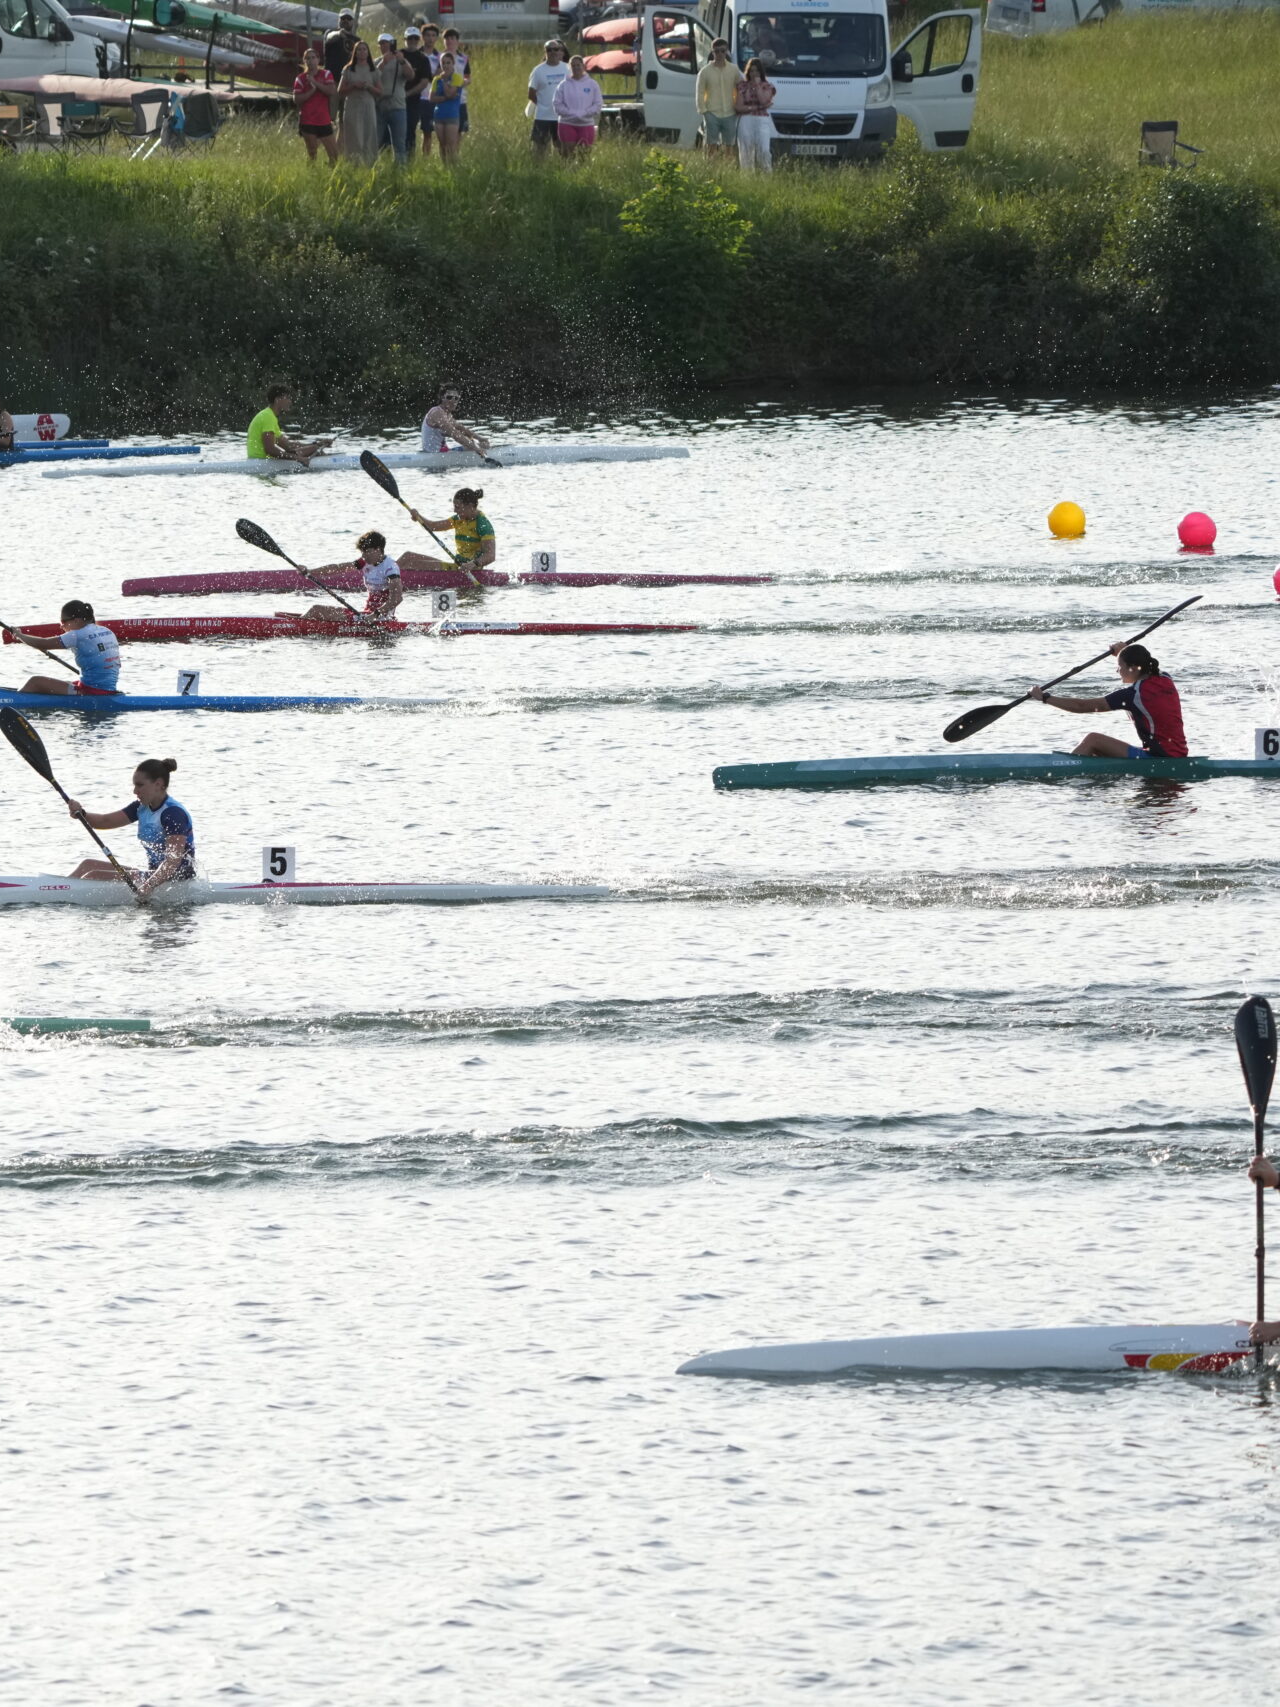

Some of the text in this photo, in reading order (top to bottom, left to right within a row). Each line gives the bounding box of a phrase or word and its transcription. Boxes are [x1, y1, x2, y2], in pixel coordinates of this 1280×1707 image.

[539, 553, 551, 572] 9
[438, 593, 451, 612] 8
[182, 674, 196, 695] 7
[1263, 728, 1280, 755] 6
[269, 847, 288, 876] 5
